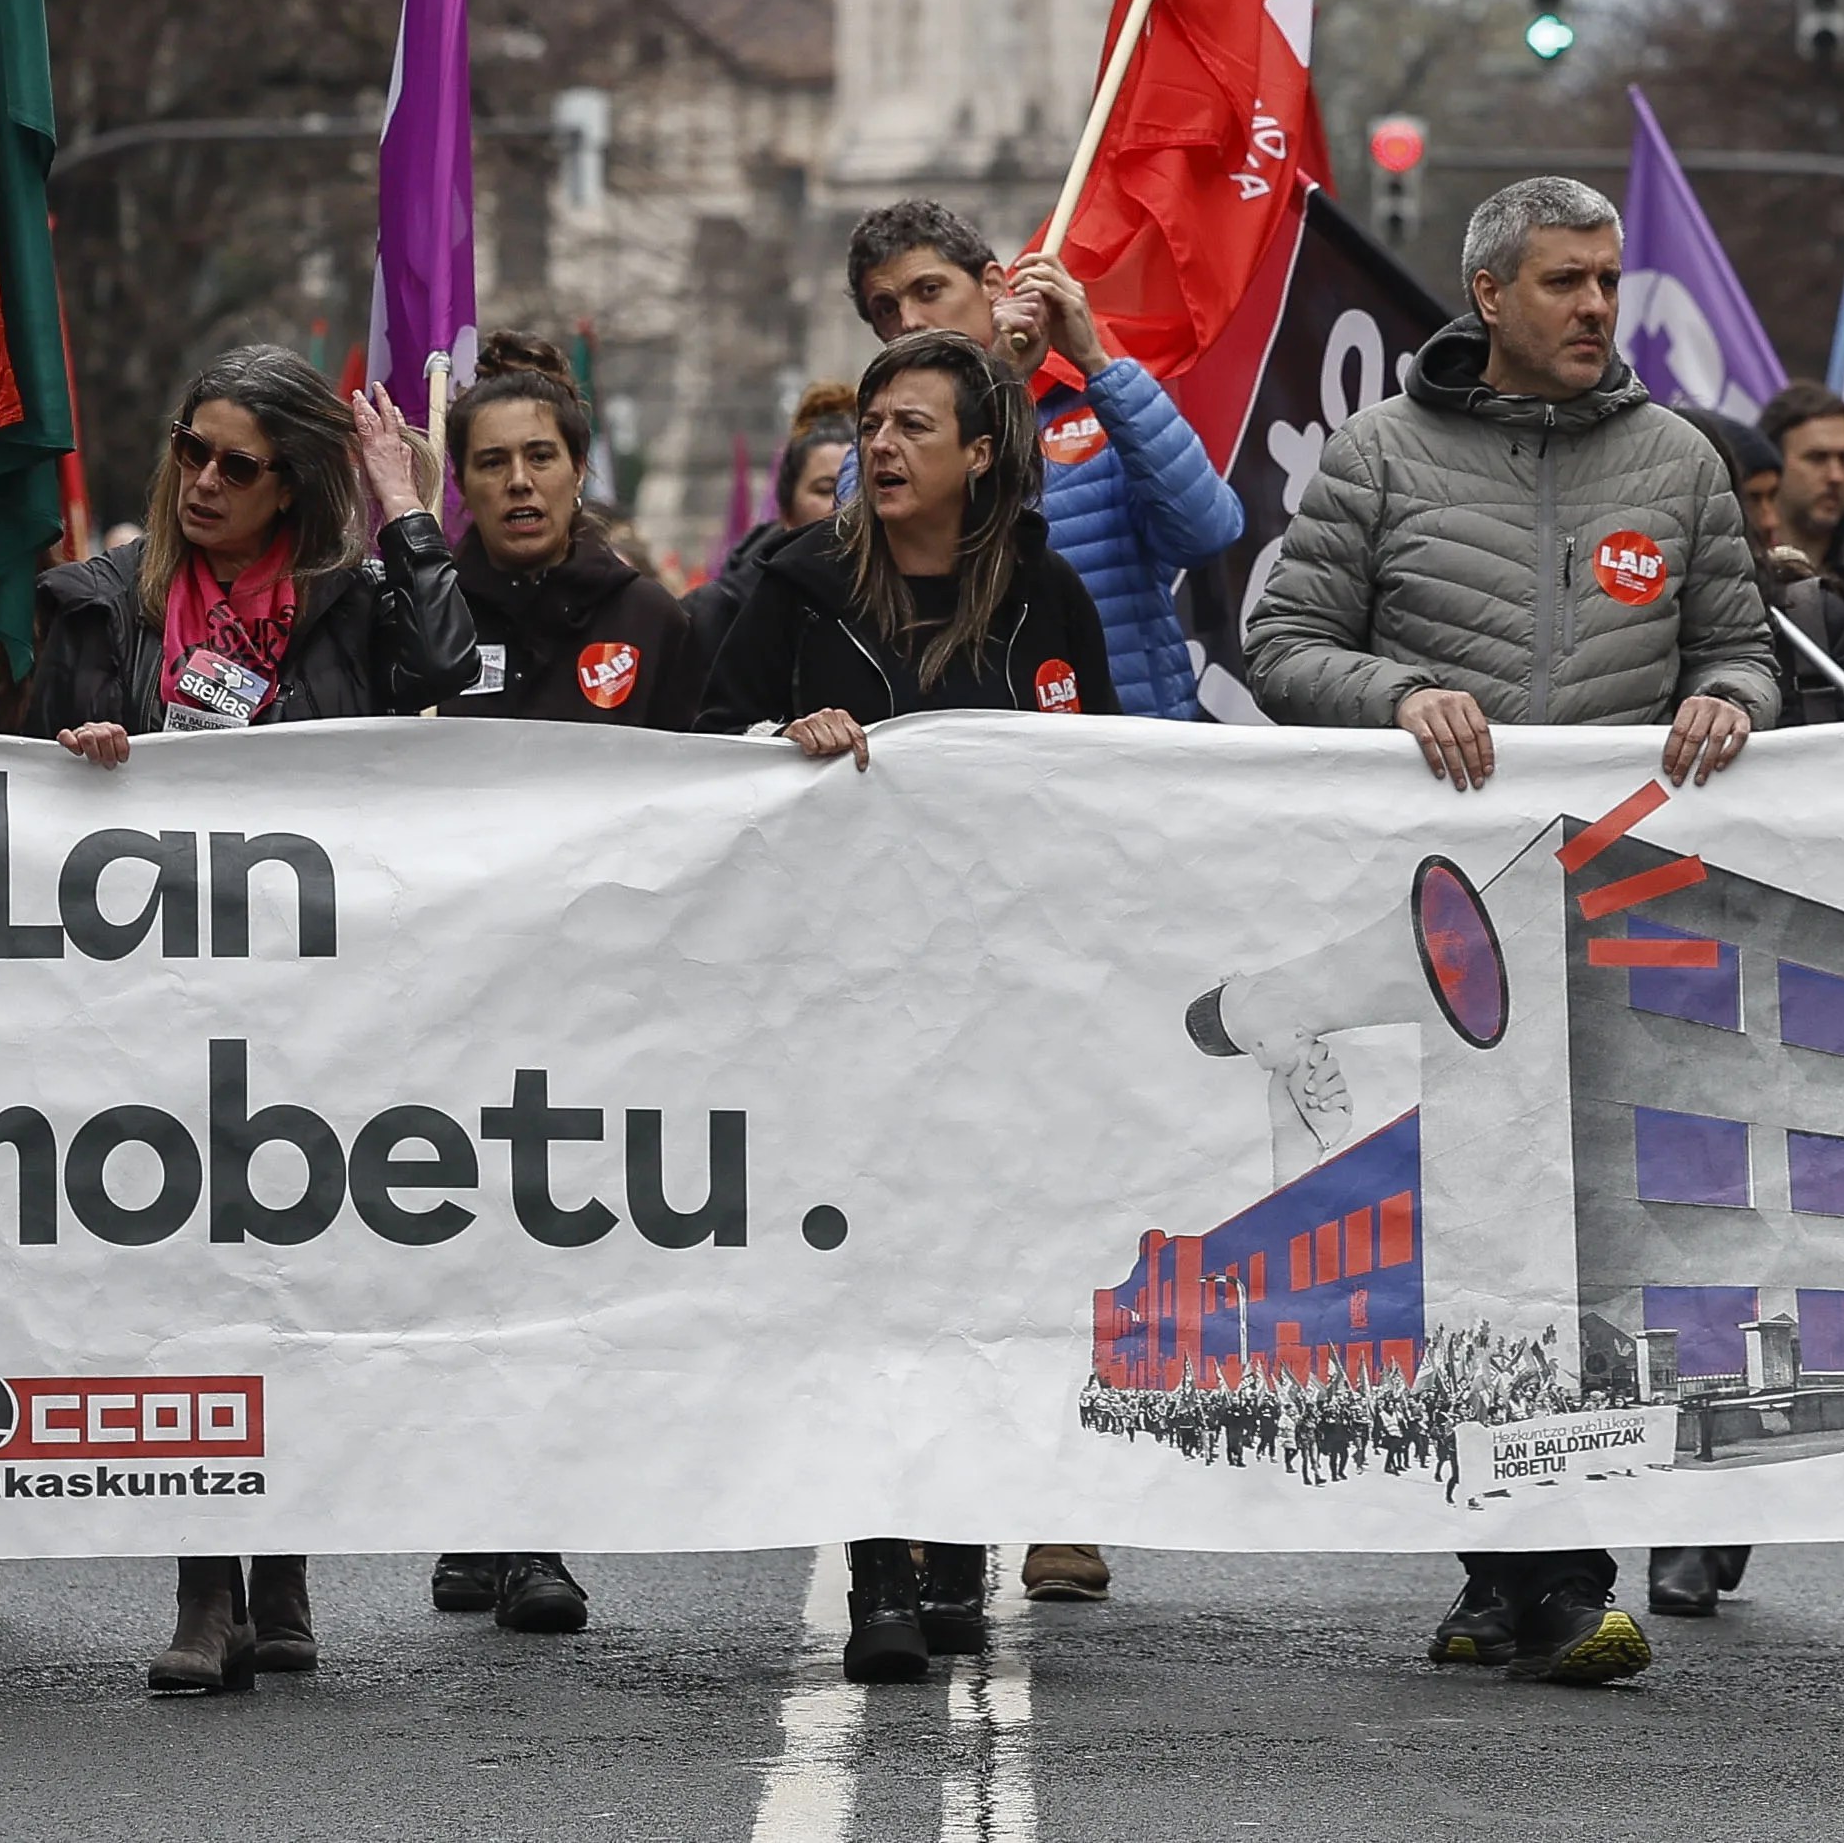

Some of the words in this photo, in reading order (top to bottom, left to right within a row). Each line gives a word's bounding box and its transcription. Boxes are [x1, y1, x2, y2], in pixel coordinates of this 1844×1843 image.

[1600, 544, 1659, 580] LAB
[580, 652, 635, 689] LAB
[179, 671, 251, 720] steilas
[1038, 677, 1077, 708] LAB
[30, 1393, 248, 1444] CCOO
[1492, 1427, 1568, 1445] Hezkuntza
[1571, 1416, 1645, 1435] publikoan
[1493, 1444, 1528, 1461] LAN
[1534, 1427, 1646, 1457] BALDINTZAK
[1493, 1455, 1568, 1480] HOBETU!
